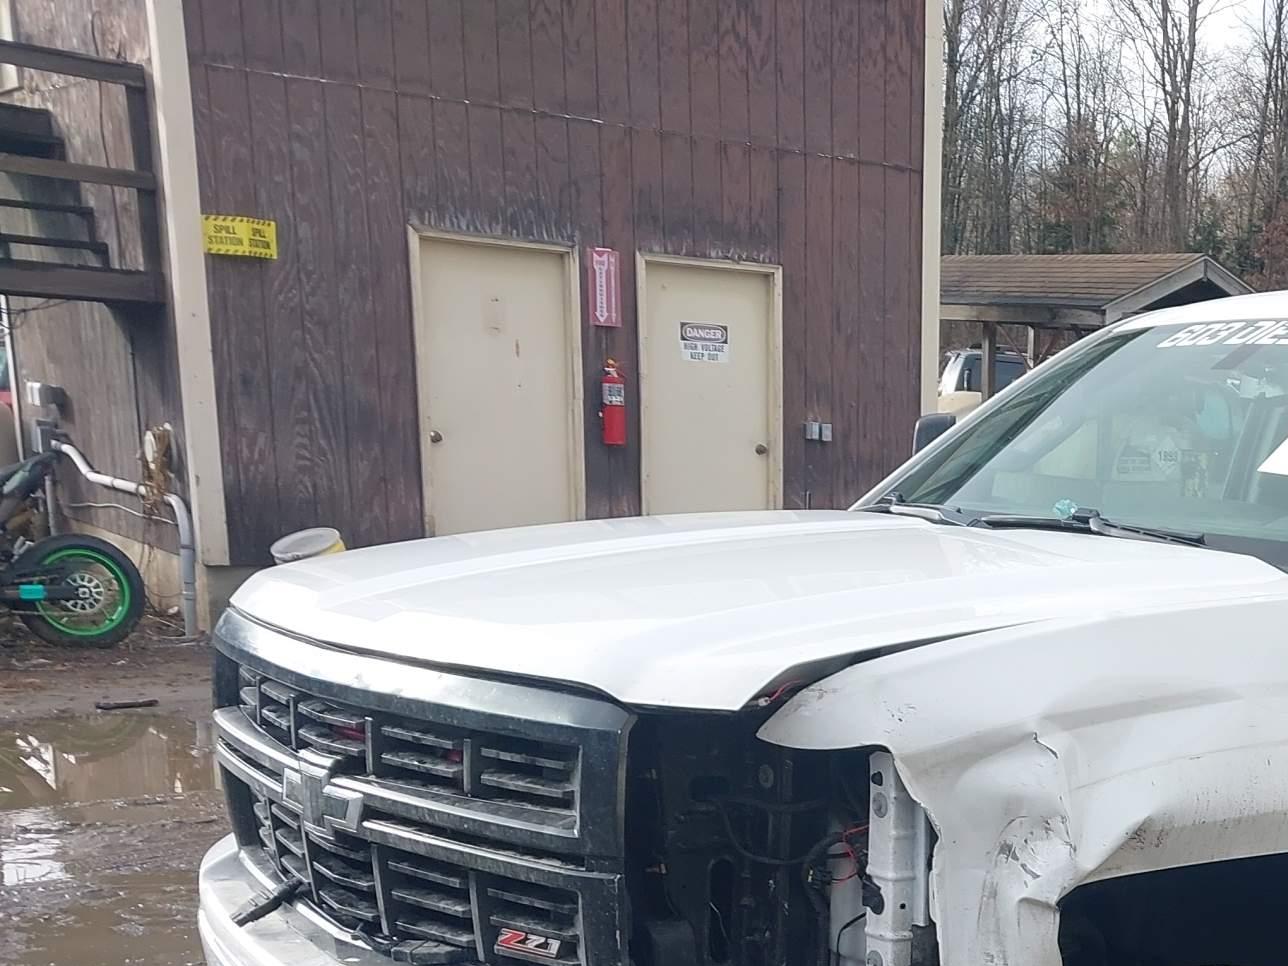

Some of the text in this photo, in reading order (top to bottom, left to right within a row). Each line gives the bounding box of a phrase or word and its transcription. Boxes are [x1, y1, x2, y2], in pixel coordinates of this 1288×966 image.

[213, 223, 237, 235] SPILL
[207, 235, 244, 247] STATION
[686, 327, 722, 340] DANGER
[497, 928, 561, 958] Z71
